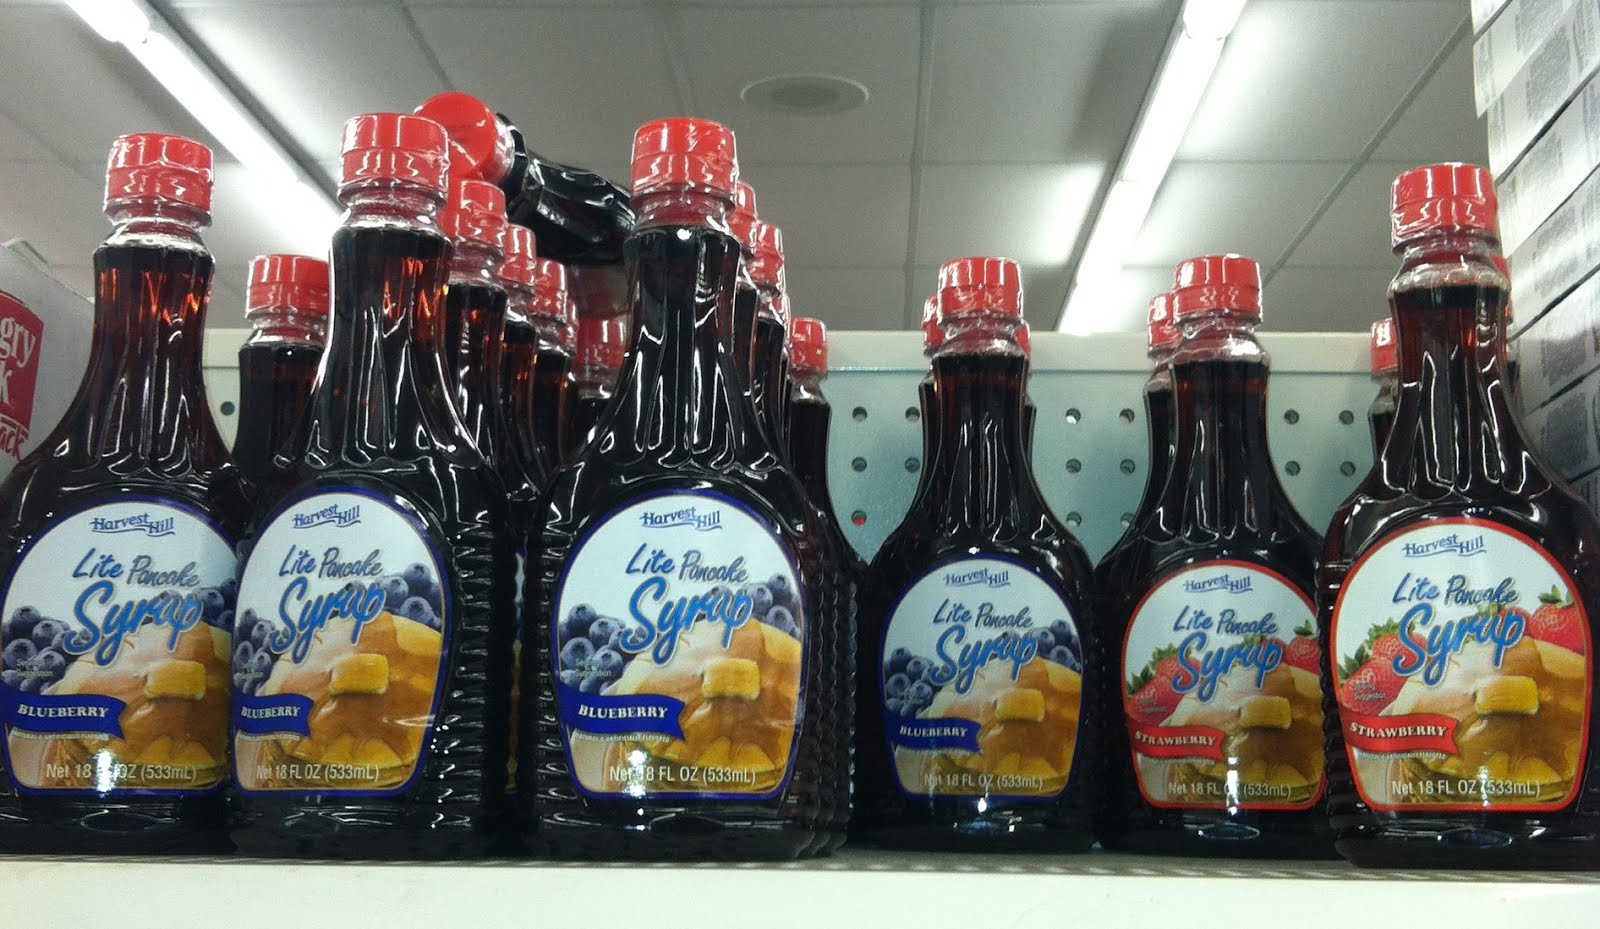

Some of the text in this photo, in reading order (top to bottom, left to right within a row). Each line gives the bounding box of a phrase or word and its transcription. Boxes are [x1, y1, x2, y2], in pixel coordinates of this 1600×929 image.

[90, 513, 174, 534] Harvest Hill
[292, 504, 360, 527] Harvest Hill
[641, 508, 721, 528] Harvest Hill
[1402, 533, 1484, 554] Harvest Hill
[72, 548, 200, 587] Lite Pancake
[279, 544, 384, 578] Lite Pancake
[625, 543, 749, 582] Lite Pancake
[944, 568, 1009, 586] Harvest Hill
[1184, 574, 1252, 591] Harvest Hill
[1392, 572, 1519, 605] Lite Pancake
[63, 580, 203, 666] Syrup
[271, 577, 386, 664] Syrup
[619, 577, 752, 665] Syrup
[933, 598, 1033, 628] Lite Pancake
[1173, 605, 1278, 636] Lite Pancake
[1392, 603, 1525, 688] Syrup
[930, 625, 1038, 696] Syrup
[1170, 632, 1283, 703] Syrup
[17, 704, 109, 718] BLUEBERRY
[240, 705, 301, 719] BLUEBERRY
[578, 704, 668, 719] BLUEBERRY
[900, 725, 968, 737] BLUEBERRY
[1135, 730, 1216, 746] STRAWBERRY
[1350, 722, 1448, 738] STRAWBERRY
[46, 764, 69, 778] Net
[75, 764, 92, 778] 18
[140, 764, 197, 782] (533mL)
[257, 764, 379, 782] Net 18 FL OZ (533mL)
[659, 766, 674, 781] FL
[680, 766, 698, 781] OZ
[703, 766, 756, 784] (533mL)
[947, 774, 959, 787] 18
[962, 774, 975, 787] FL
[978, 774, 994, 787] OZ
[997, 774, 1043, 790] (533mL)
[1168, 782, 1186, 795] Net
[1191, 782, 1204, 795] 18
[1207, 782, 1220, 795] FL
[1243, 783, 1291, 798] (533mL)
[1392, 779, 1541, 799] Net 18 FL OZ (533mL)
